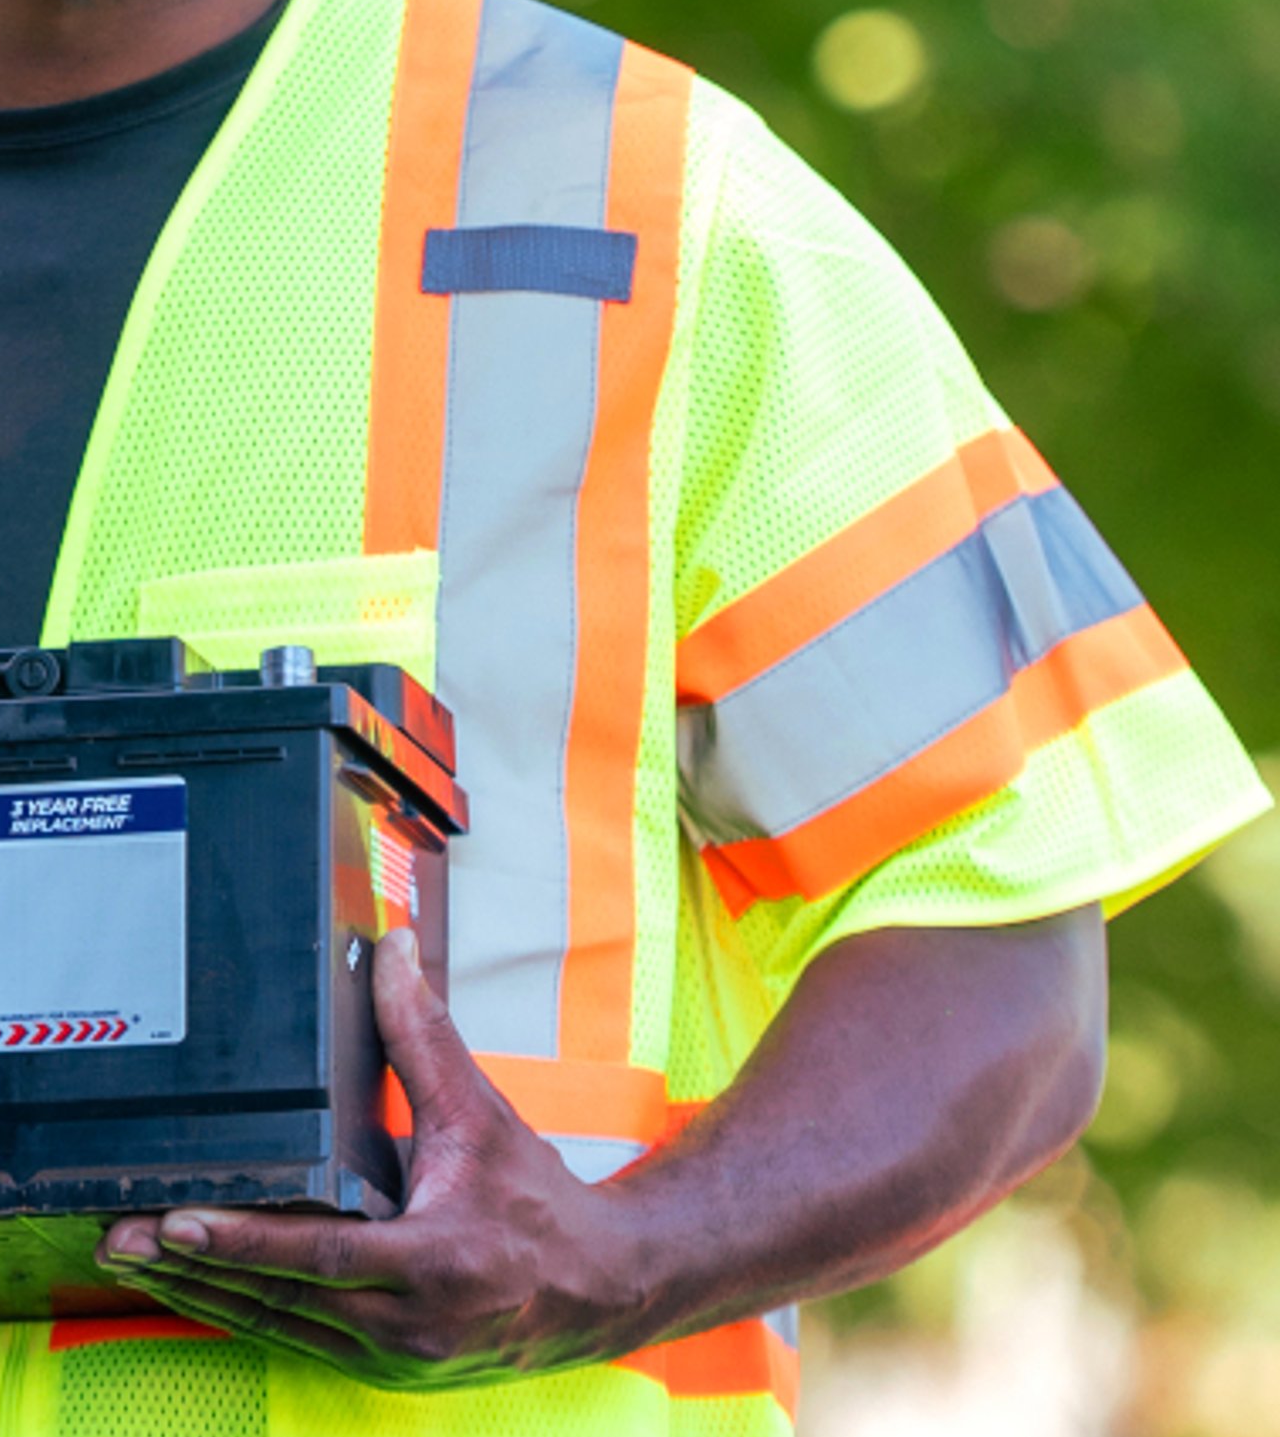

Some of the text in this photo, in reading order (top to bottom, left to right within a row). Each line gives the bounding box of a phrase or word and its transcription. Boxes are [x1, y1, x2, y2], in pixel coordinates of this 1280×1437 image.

[10, 794, 132, 818] 3 YEAR FREE
[9, 814, 129, 834] REPLACEMENT
